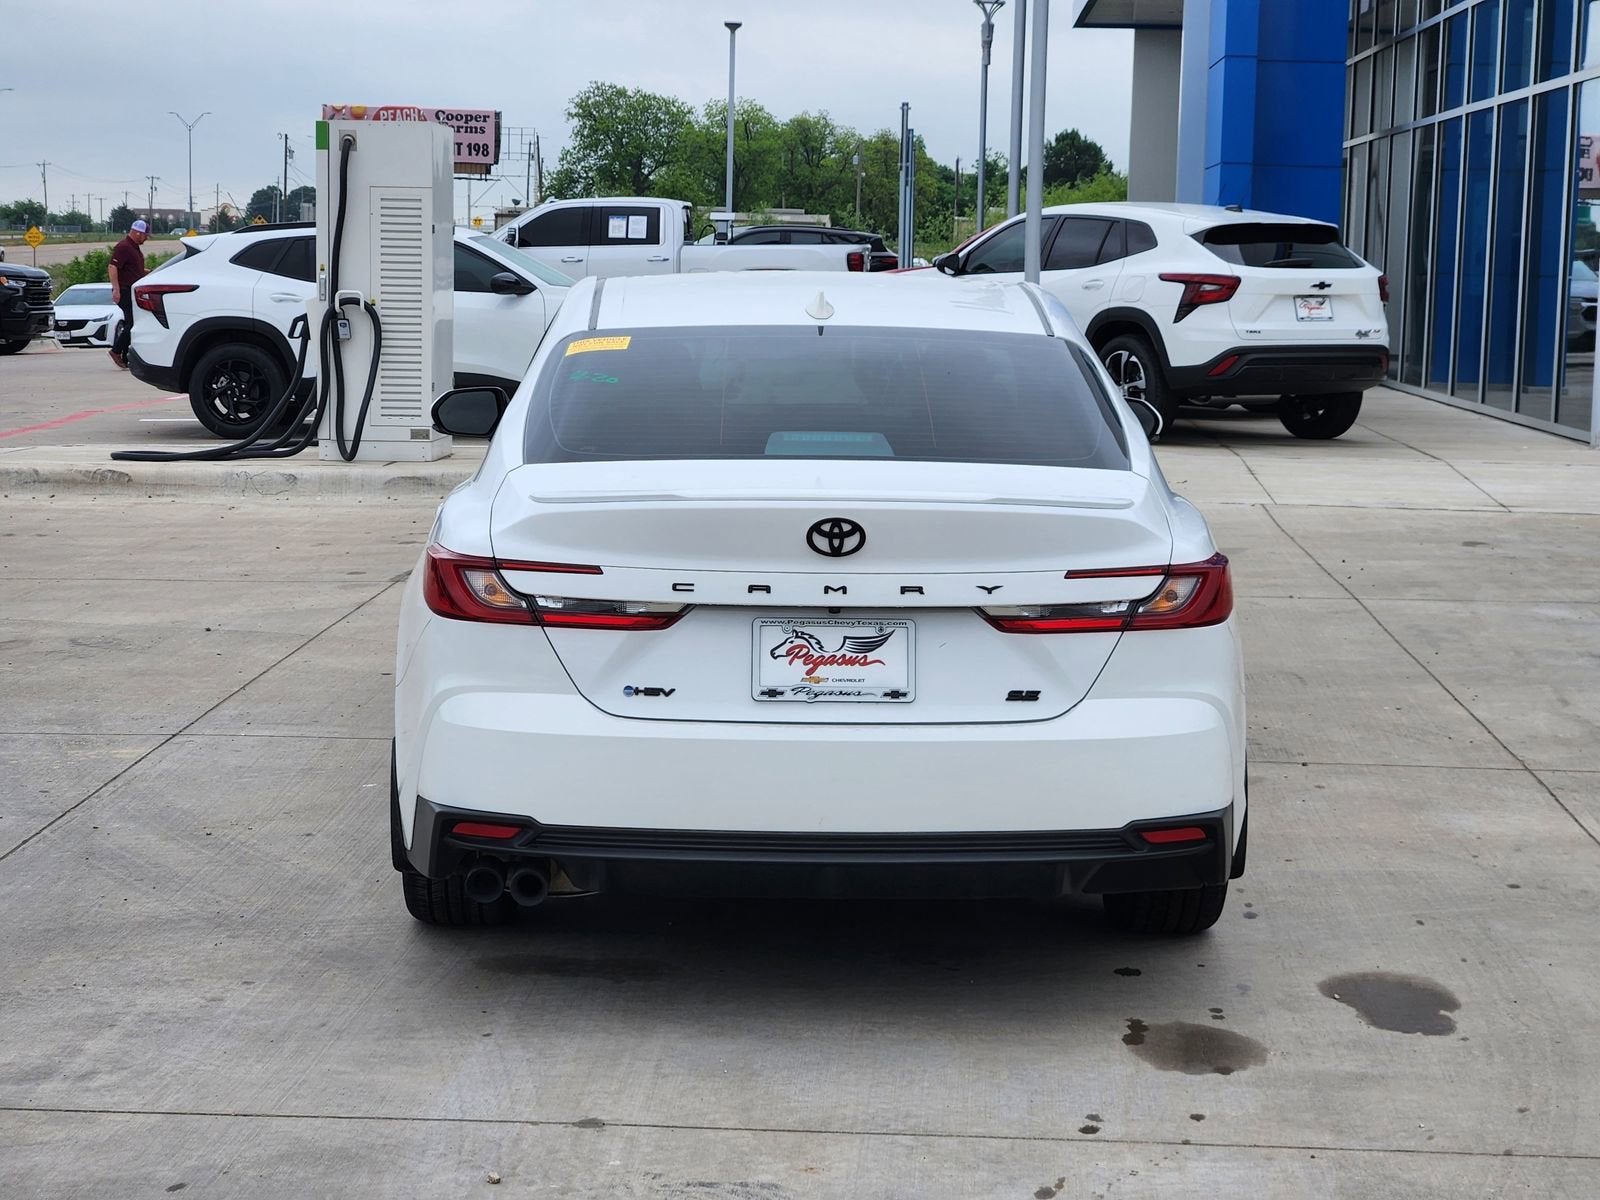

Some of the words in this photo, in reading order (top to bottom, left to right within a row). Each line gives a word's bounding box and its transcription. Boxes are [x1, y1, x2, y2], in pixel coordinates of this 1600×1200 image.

[380, 108, 418, 121] PEACH
[435, 110, 490, 124] Cooper
[466, 143, 489, 157] 198
[672, 582, 1003, 595] CAMRY
[785, 643, 886, 676] Pegasus
[633, 686, 676, 697] HEV
[791, 686, 877, 700] Pegasus
[1005, 690, 1042, 701] SE
